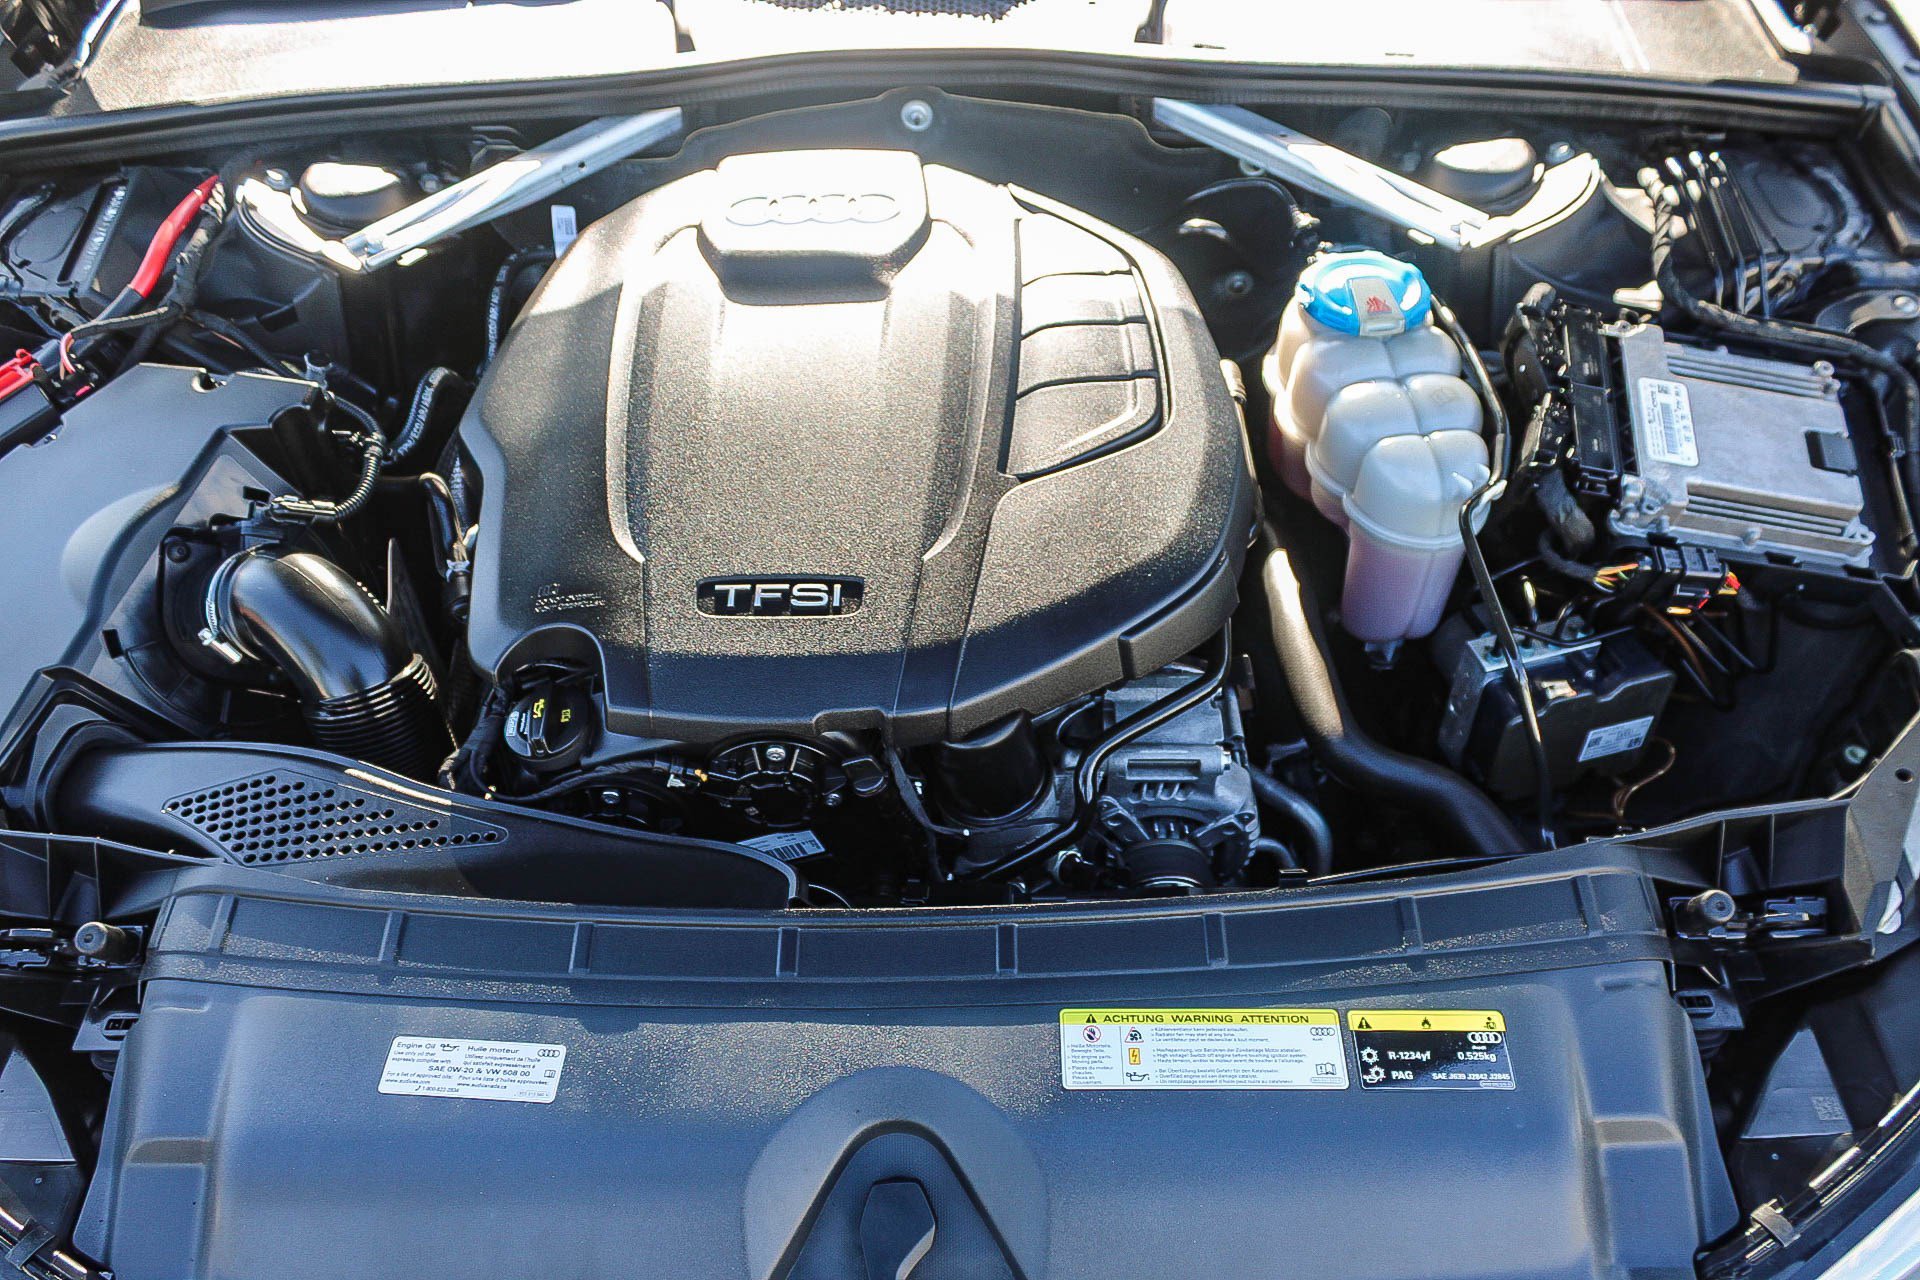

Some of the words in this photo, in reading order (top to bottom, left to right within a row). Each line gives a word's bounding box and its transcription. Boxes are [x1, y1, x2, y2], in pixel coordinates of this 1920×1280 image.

[714, 584, 842, 607] TFSI
[1103, 1014, 1164, 1022] ACHTUNG
[1171, 1014, 1234, 1022] WARNING
[1240, 1015, 1309, 1023] ATTENTION
[1387, 1050, 1430, 1061] R-1234yf
[1457, 1052, 1496, 1062] 0.525kg
[1391, 1070, 1414, 1080] PAG
